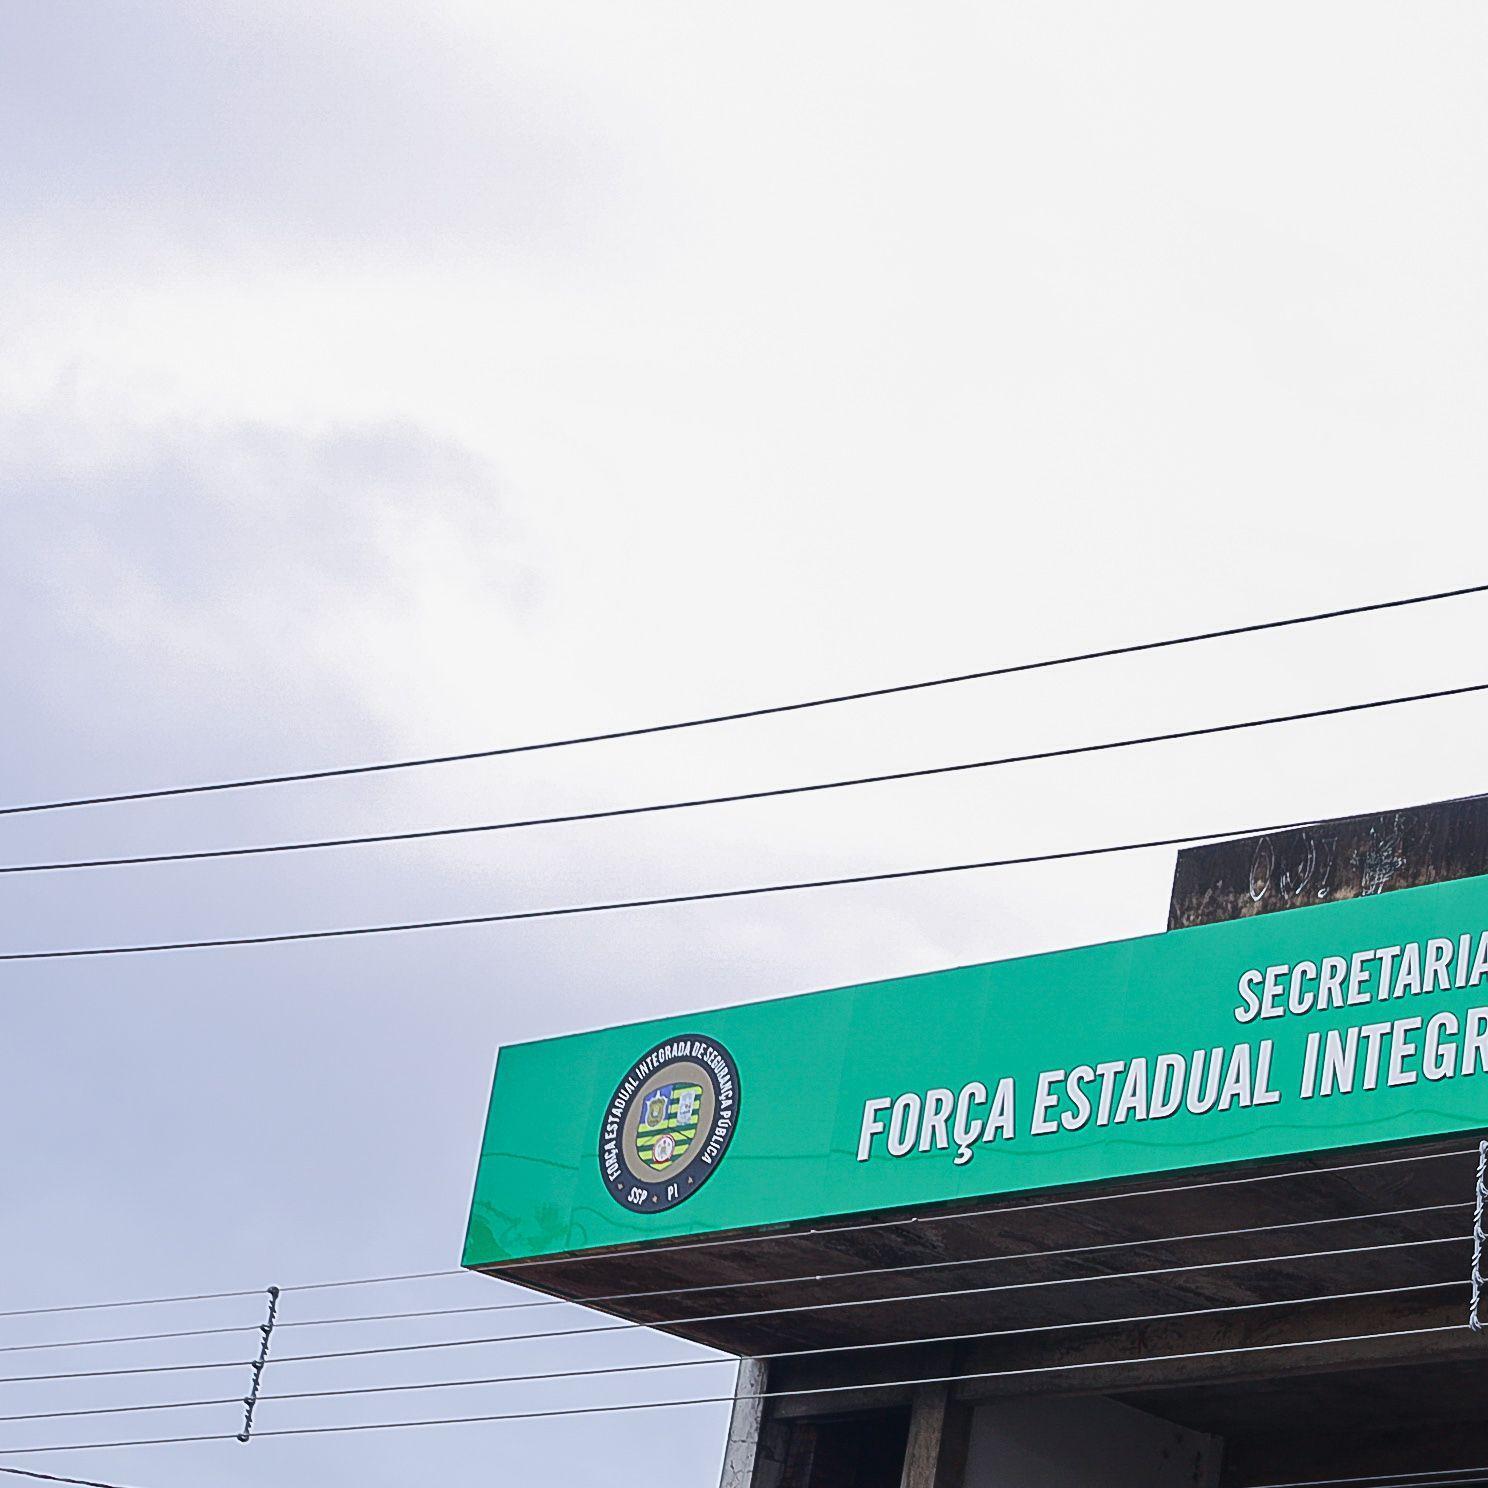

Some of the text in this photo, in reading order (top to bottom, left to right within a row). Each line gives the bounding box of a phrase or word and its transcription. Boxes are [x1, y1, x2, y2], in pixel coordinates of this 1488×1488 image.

[604, 1041, 733, 1182] FORÇA ESTADUAL INTEGRADA DE SEGURANÇA PÚBLICA
[856, 1076, 1016, 1166] FORÇA
[1030, 1038, 1282, 1137] ESTADUAL
[627, 1186, 648, 1206] SSP
